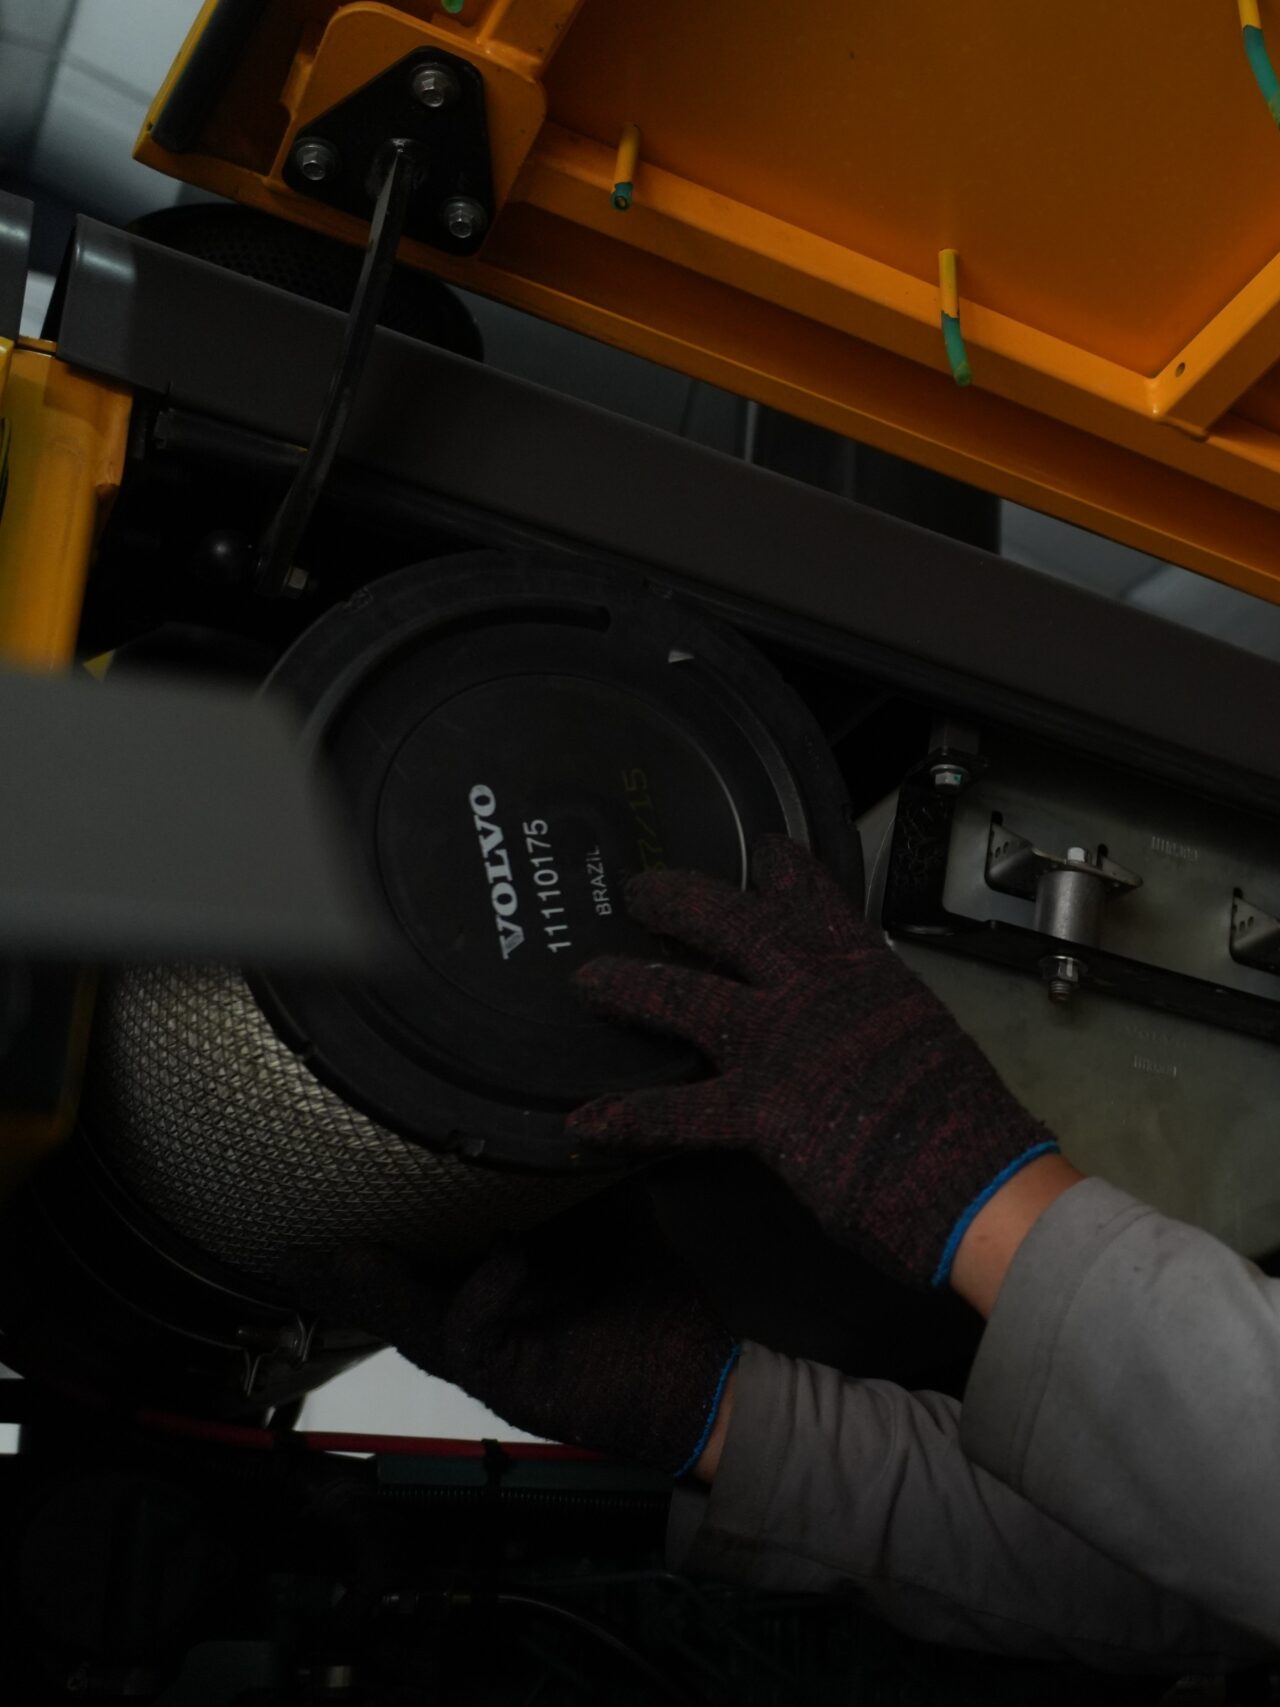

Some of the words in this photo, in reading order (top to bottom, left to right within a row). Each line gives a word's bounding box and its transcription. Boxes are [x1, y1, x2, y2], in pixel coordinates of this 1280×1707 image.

[468, 784, 525, 960] VOLVO
[522, 819, 572, 953] 11110175
[586, 845, 613, 916] BRAZIL
